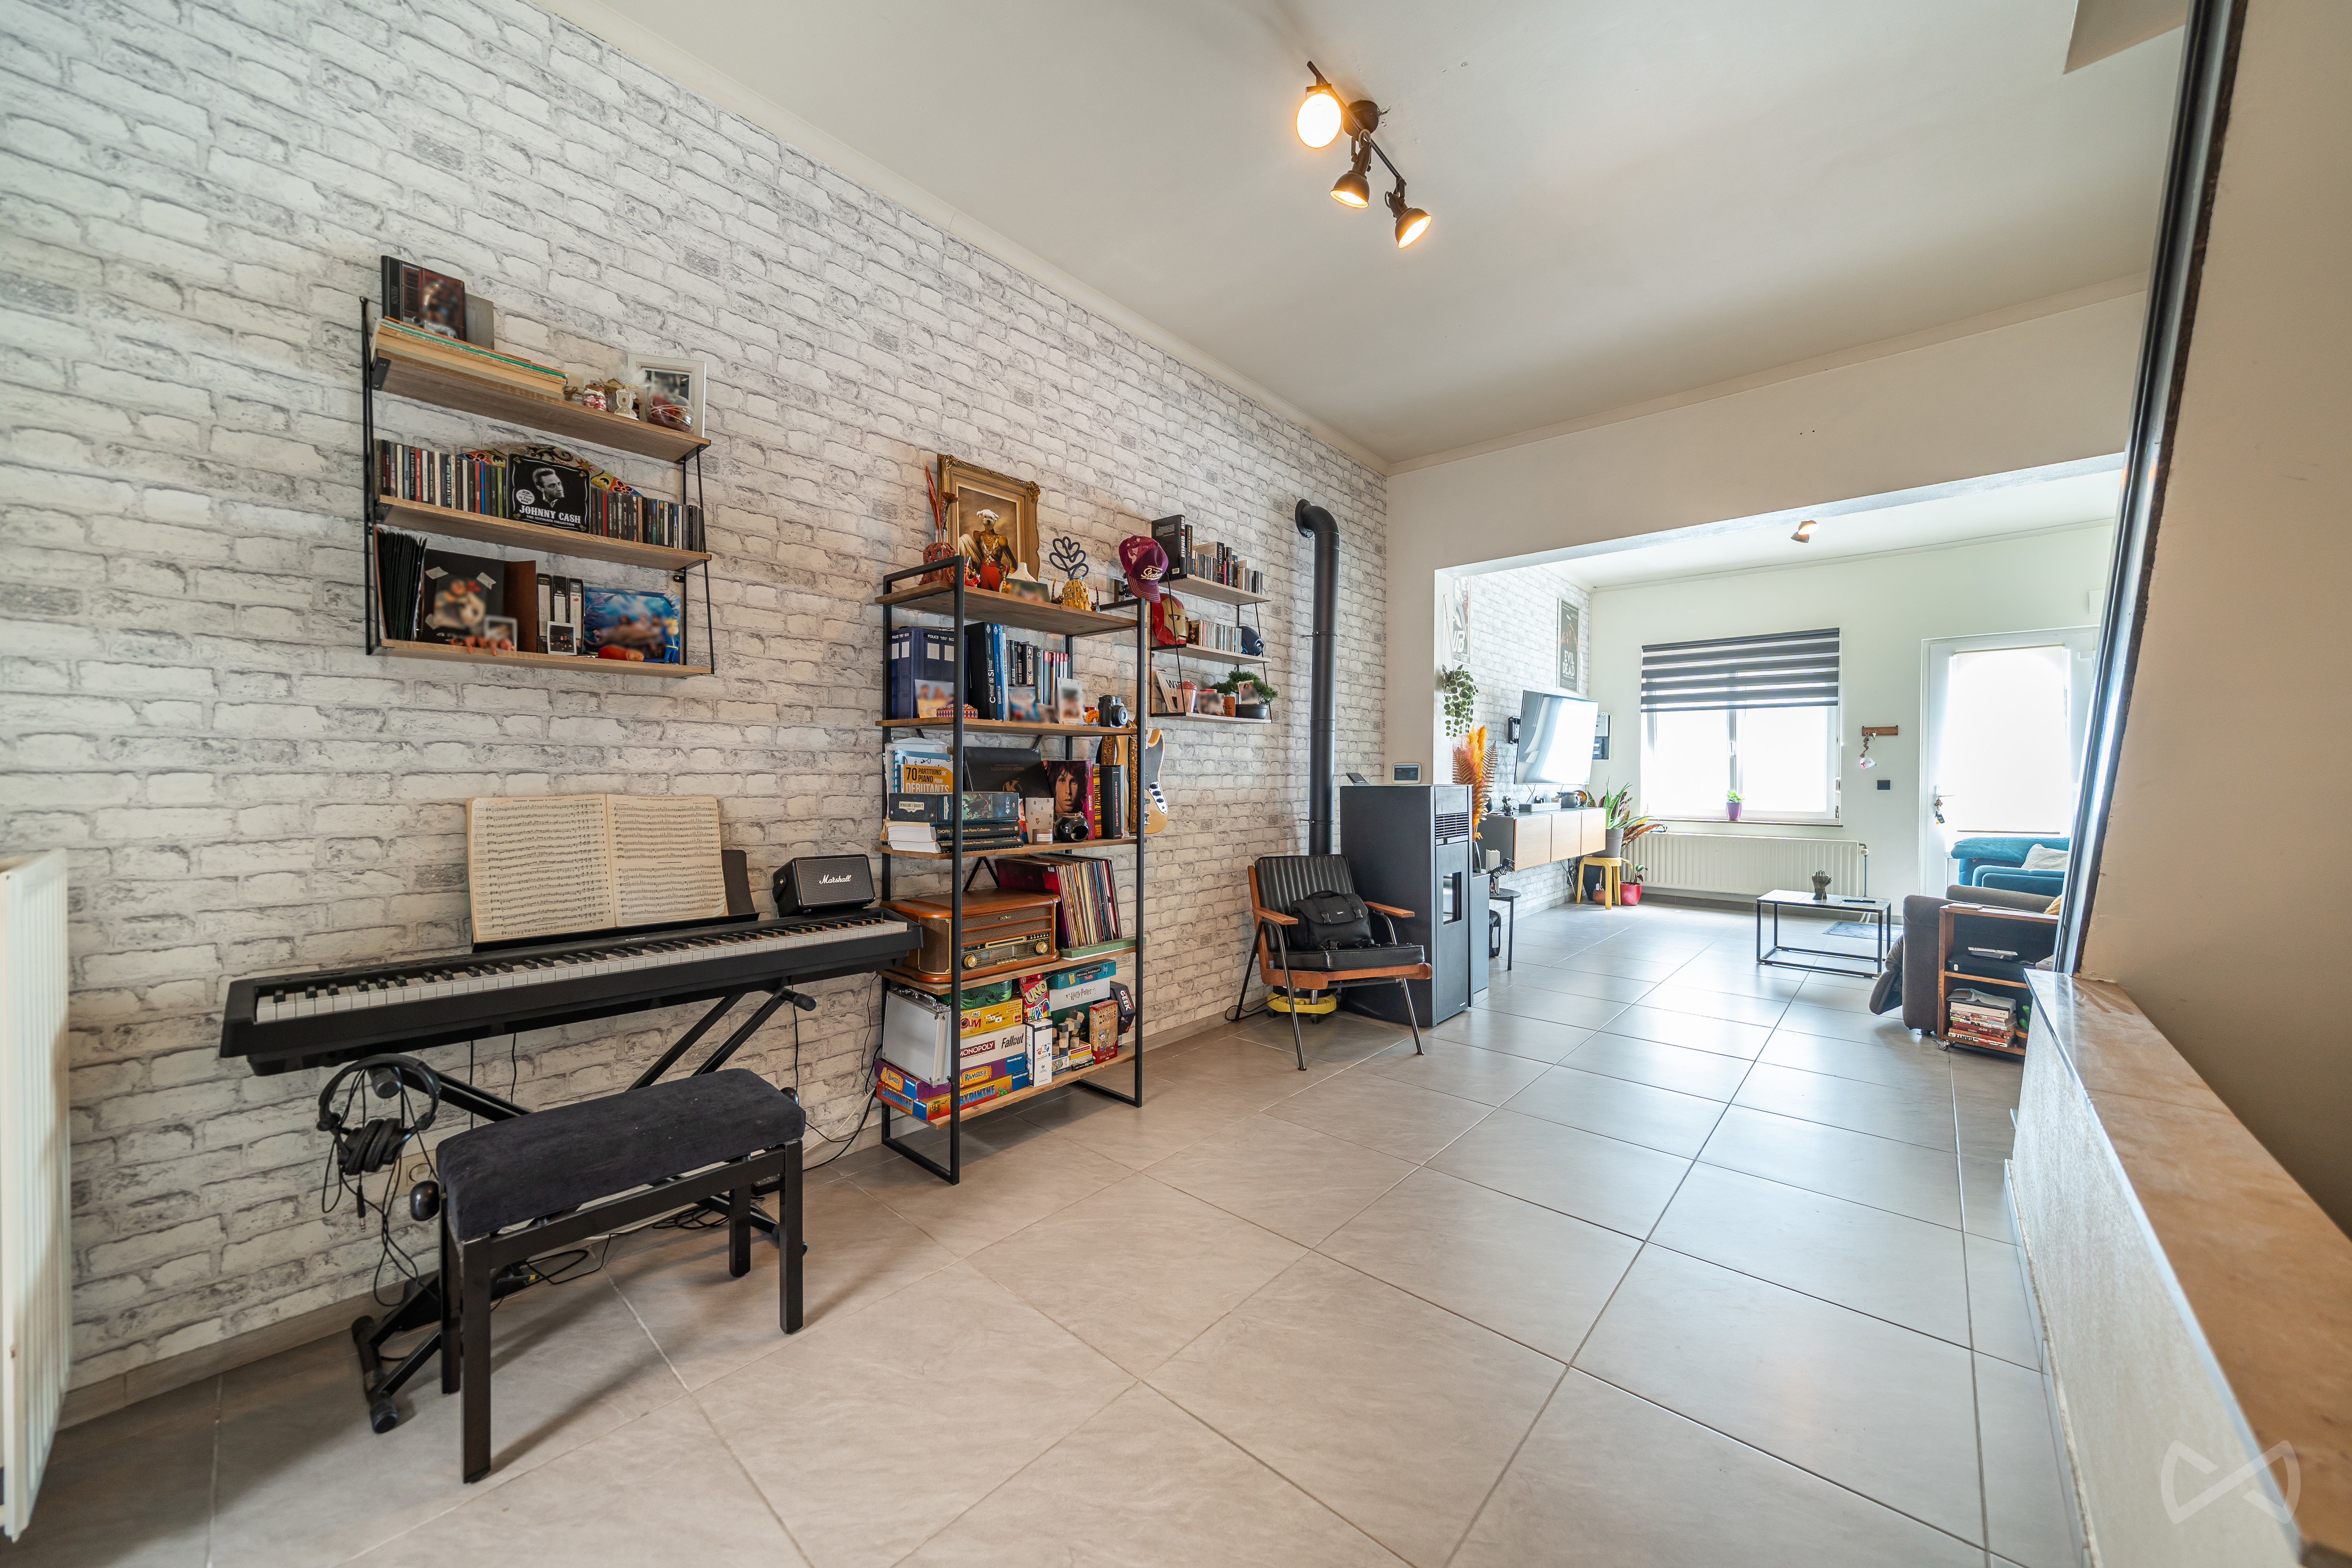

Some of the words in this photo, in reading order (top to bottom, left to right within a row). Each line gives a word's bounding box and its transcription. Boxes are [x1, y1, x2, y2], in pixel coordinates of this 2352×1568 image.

[519, 505, 556, 519] JOHNNY
[559, 512, 581, 524] CASH
[1564, 650, 1574, 665] EVIL
[1562, 662, 1575, 677] DEAD
[1088, 711, 1096, 719] TANUKI
[905, 767, 917, 781] 70
[906, 781, 950, 793] DÉBUTANTS
[819, 875, 851, 884] Marshall
[1024, 980, 1047, 1004] UNO
[1070, 991, 1081, 1001] Harry
[1081, 988, 1092, 999] Potter
[1120, 990, 1131, 1011] GEEK
[1098, 1004, 1117, 1015] MUNCHKIN
[961, 1018, 981, 1029] OUM
[1098, 1010, 1116, 1025] ZOMBIES
[1001, 1033, 1024, 1049] Fallout
[961, 1042, 994, 1056] MONOPOLY
[888, 1072, 897, 1084] RAMSES
[965, 1071, 983, 1081] RAMSES
[1012, 1071, 1028, 1080] Ravensburger
[882, 1084, 912, 1109] LABYRINTHE
[960, 1083, 995, 1106] BYRINTHE
[914, 1099, 926, 1108] Ravensburger
